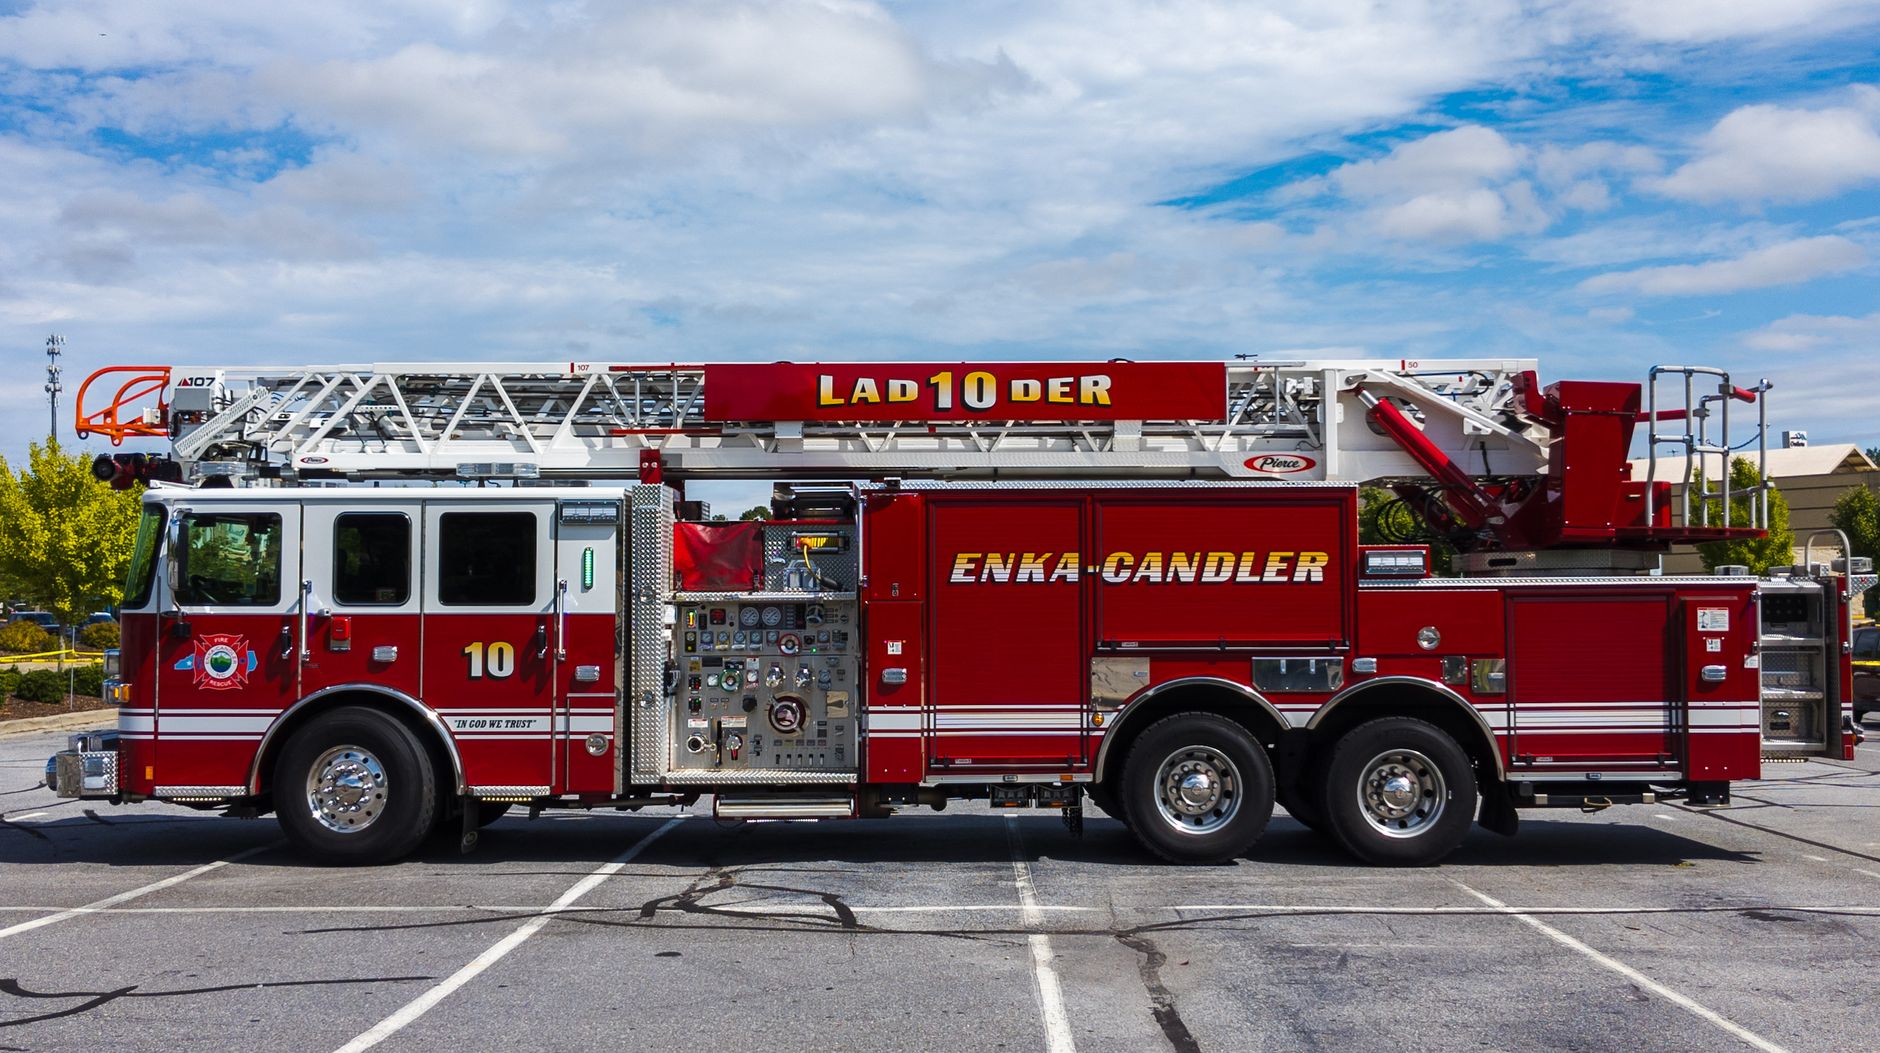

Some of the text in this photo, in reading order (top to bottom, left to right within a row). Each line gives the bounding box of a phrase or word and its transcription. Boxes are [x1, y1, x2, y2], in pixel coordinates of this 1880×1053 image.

[1408, 361, 1418, 369] 50
[188, 377, 216, 387] 107
[818, 371, 1112, 410] LAD 10 DER
[1259, 456, 1300, 471] Pierce
[949, 551, 1329, 584] ENKA-CANDLER
[463, 641, 515, 678] 10
[209, 679, 232, 687] RESCUE
[468, 719, 487, 729] GOD
[489, 719, 502, 729] WE
[504, 719, 537, 729] TRUST"
